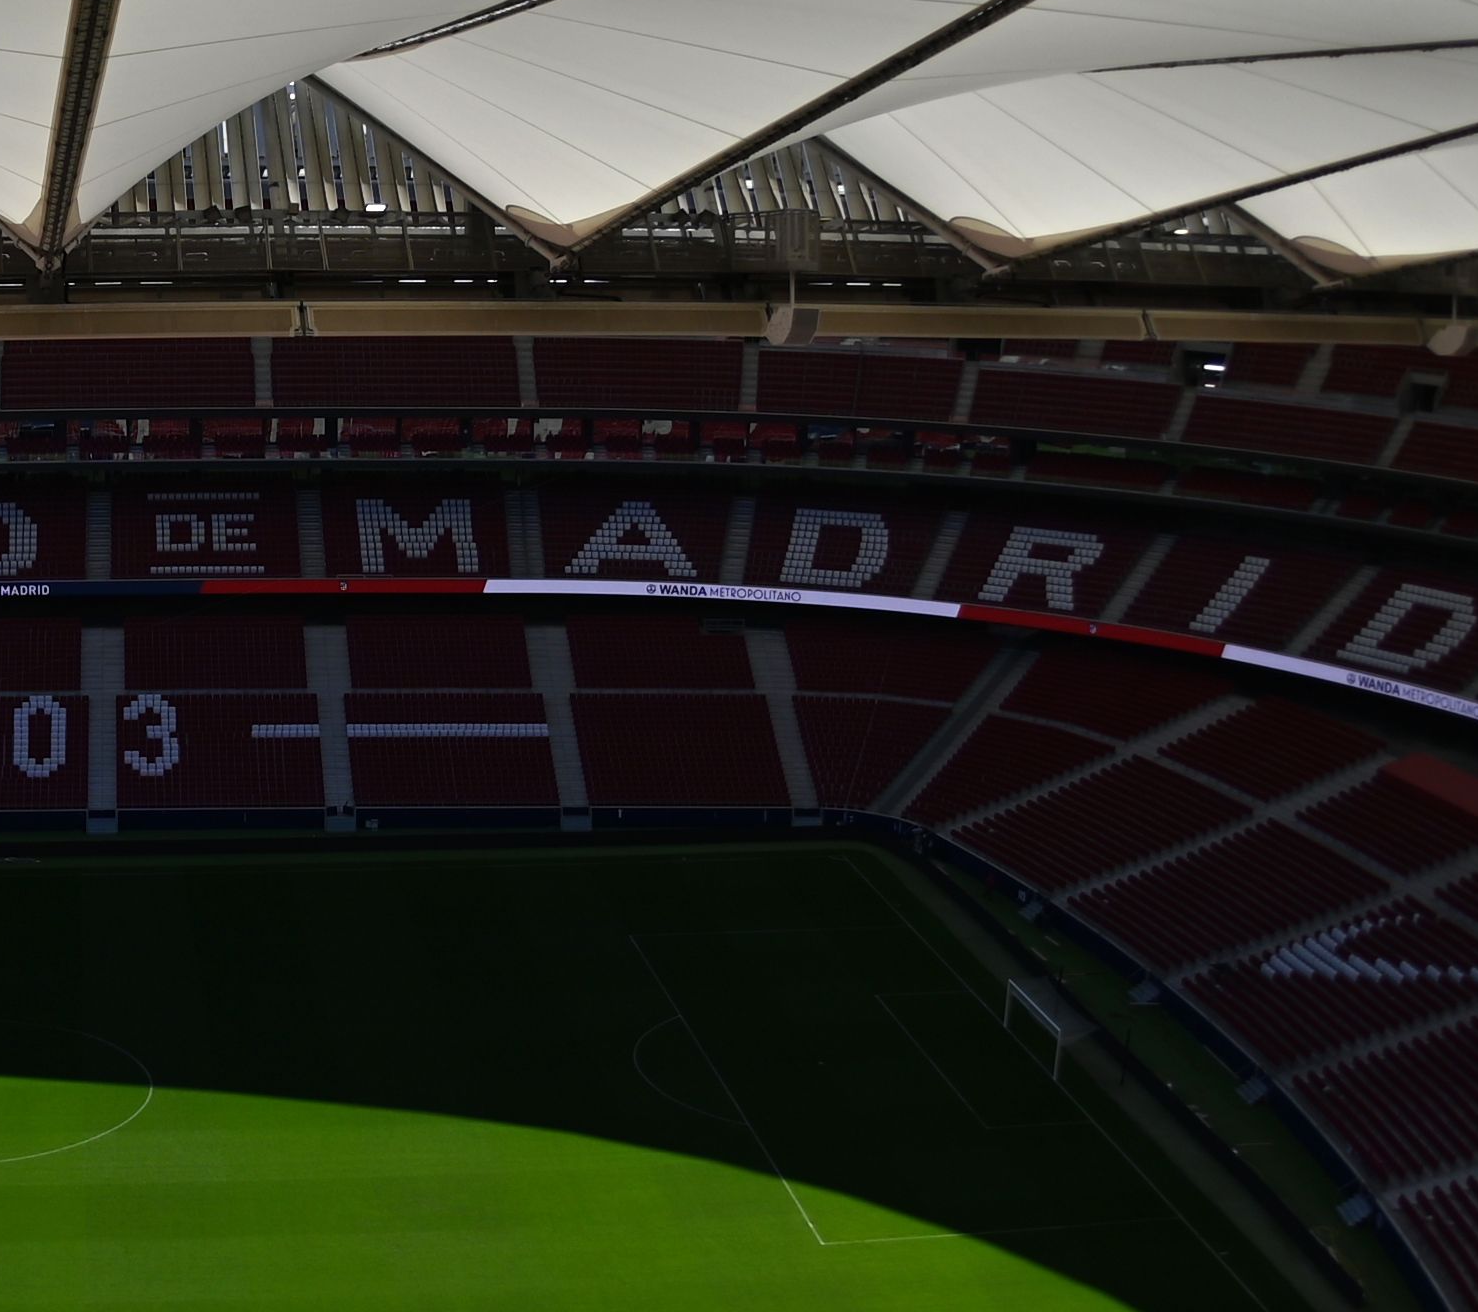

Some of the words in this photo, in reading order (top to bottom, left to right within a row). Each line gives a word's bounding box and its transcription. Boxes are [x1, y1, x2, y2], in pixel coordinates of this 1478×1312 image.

[0, 584, 50, 597] MADRID
[154, 512, 258, 553] DE
[355, 497, 1477, 675] MADRID
[659, 584, 707, 597] WANDA
[709, 587, 802, 602] METROPOLITANO
[1358, 675, 1401, 696] WANDA
